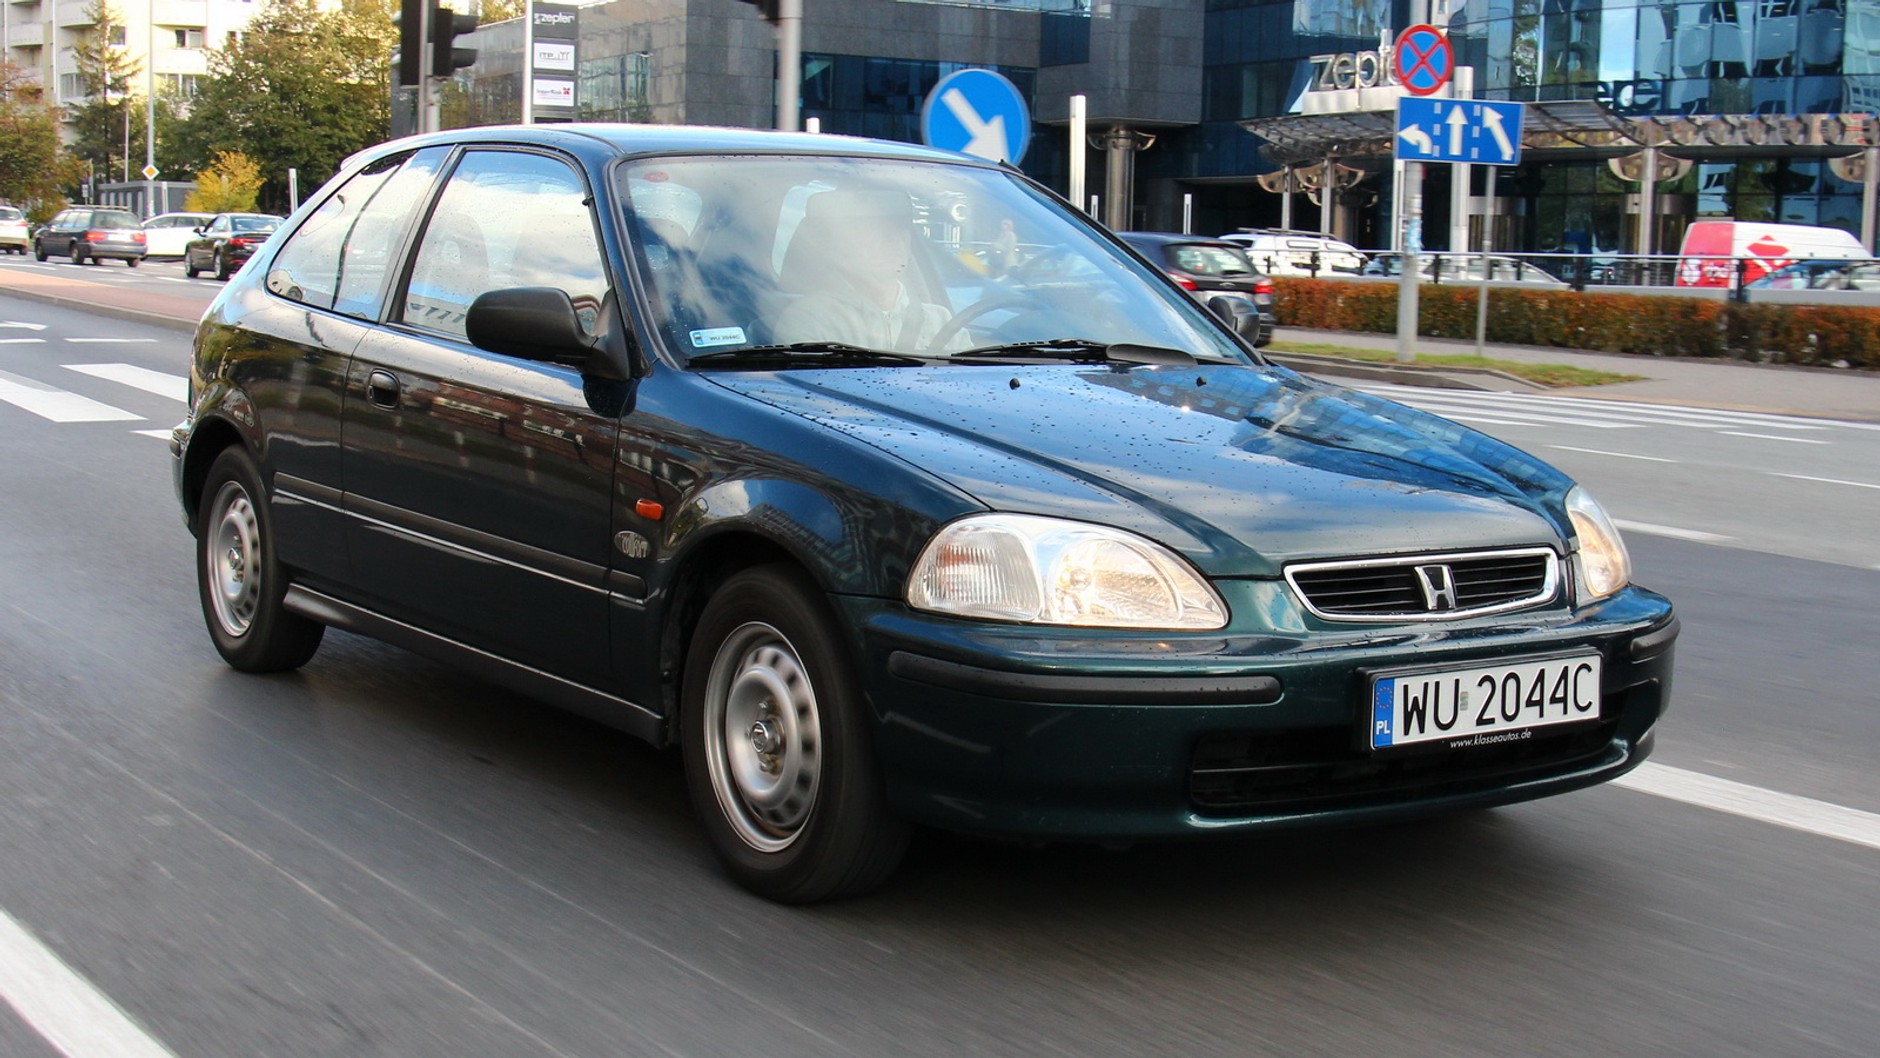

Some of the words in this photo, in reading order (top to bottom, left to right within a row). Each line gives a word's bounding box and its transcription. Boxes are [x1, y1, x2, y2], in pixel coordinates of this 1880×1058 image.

[1310, 29, 1400, 108] zepte
[1403, 679, 1460, 735] WU
[1476, 663, 1593, 726] 2044C
[1376, 720, 1391, 735] PL
[1450, 728, 1532, 748] www.klasseautos.de
